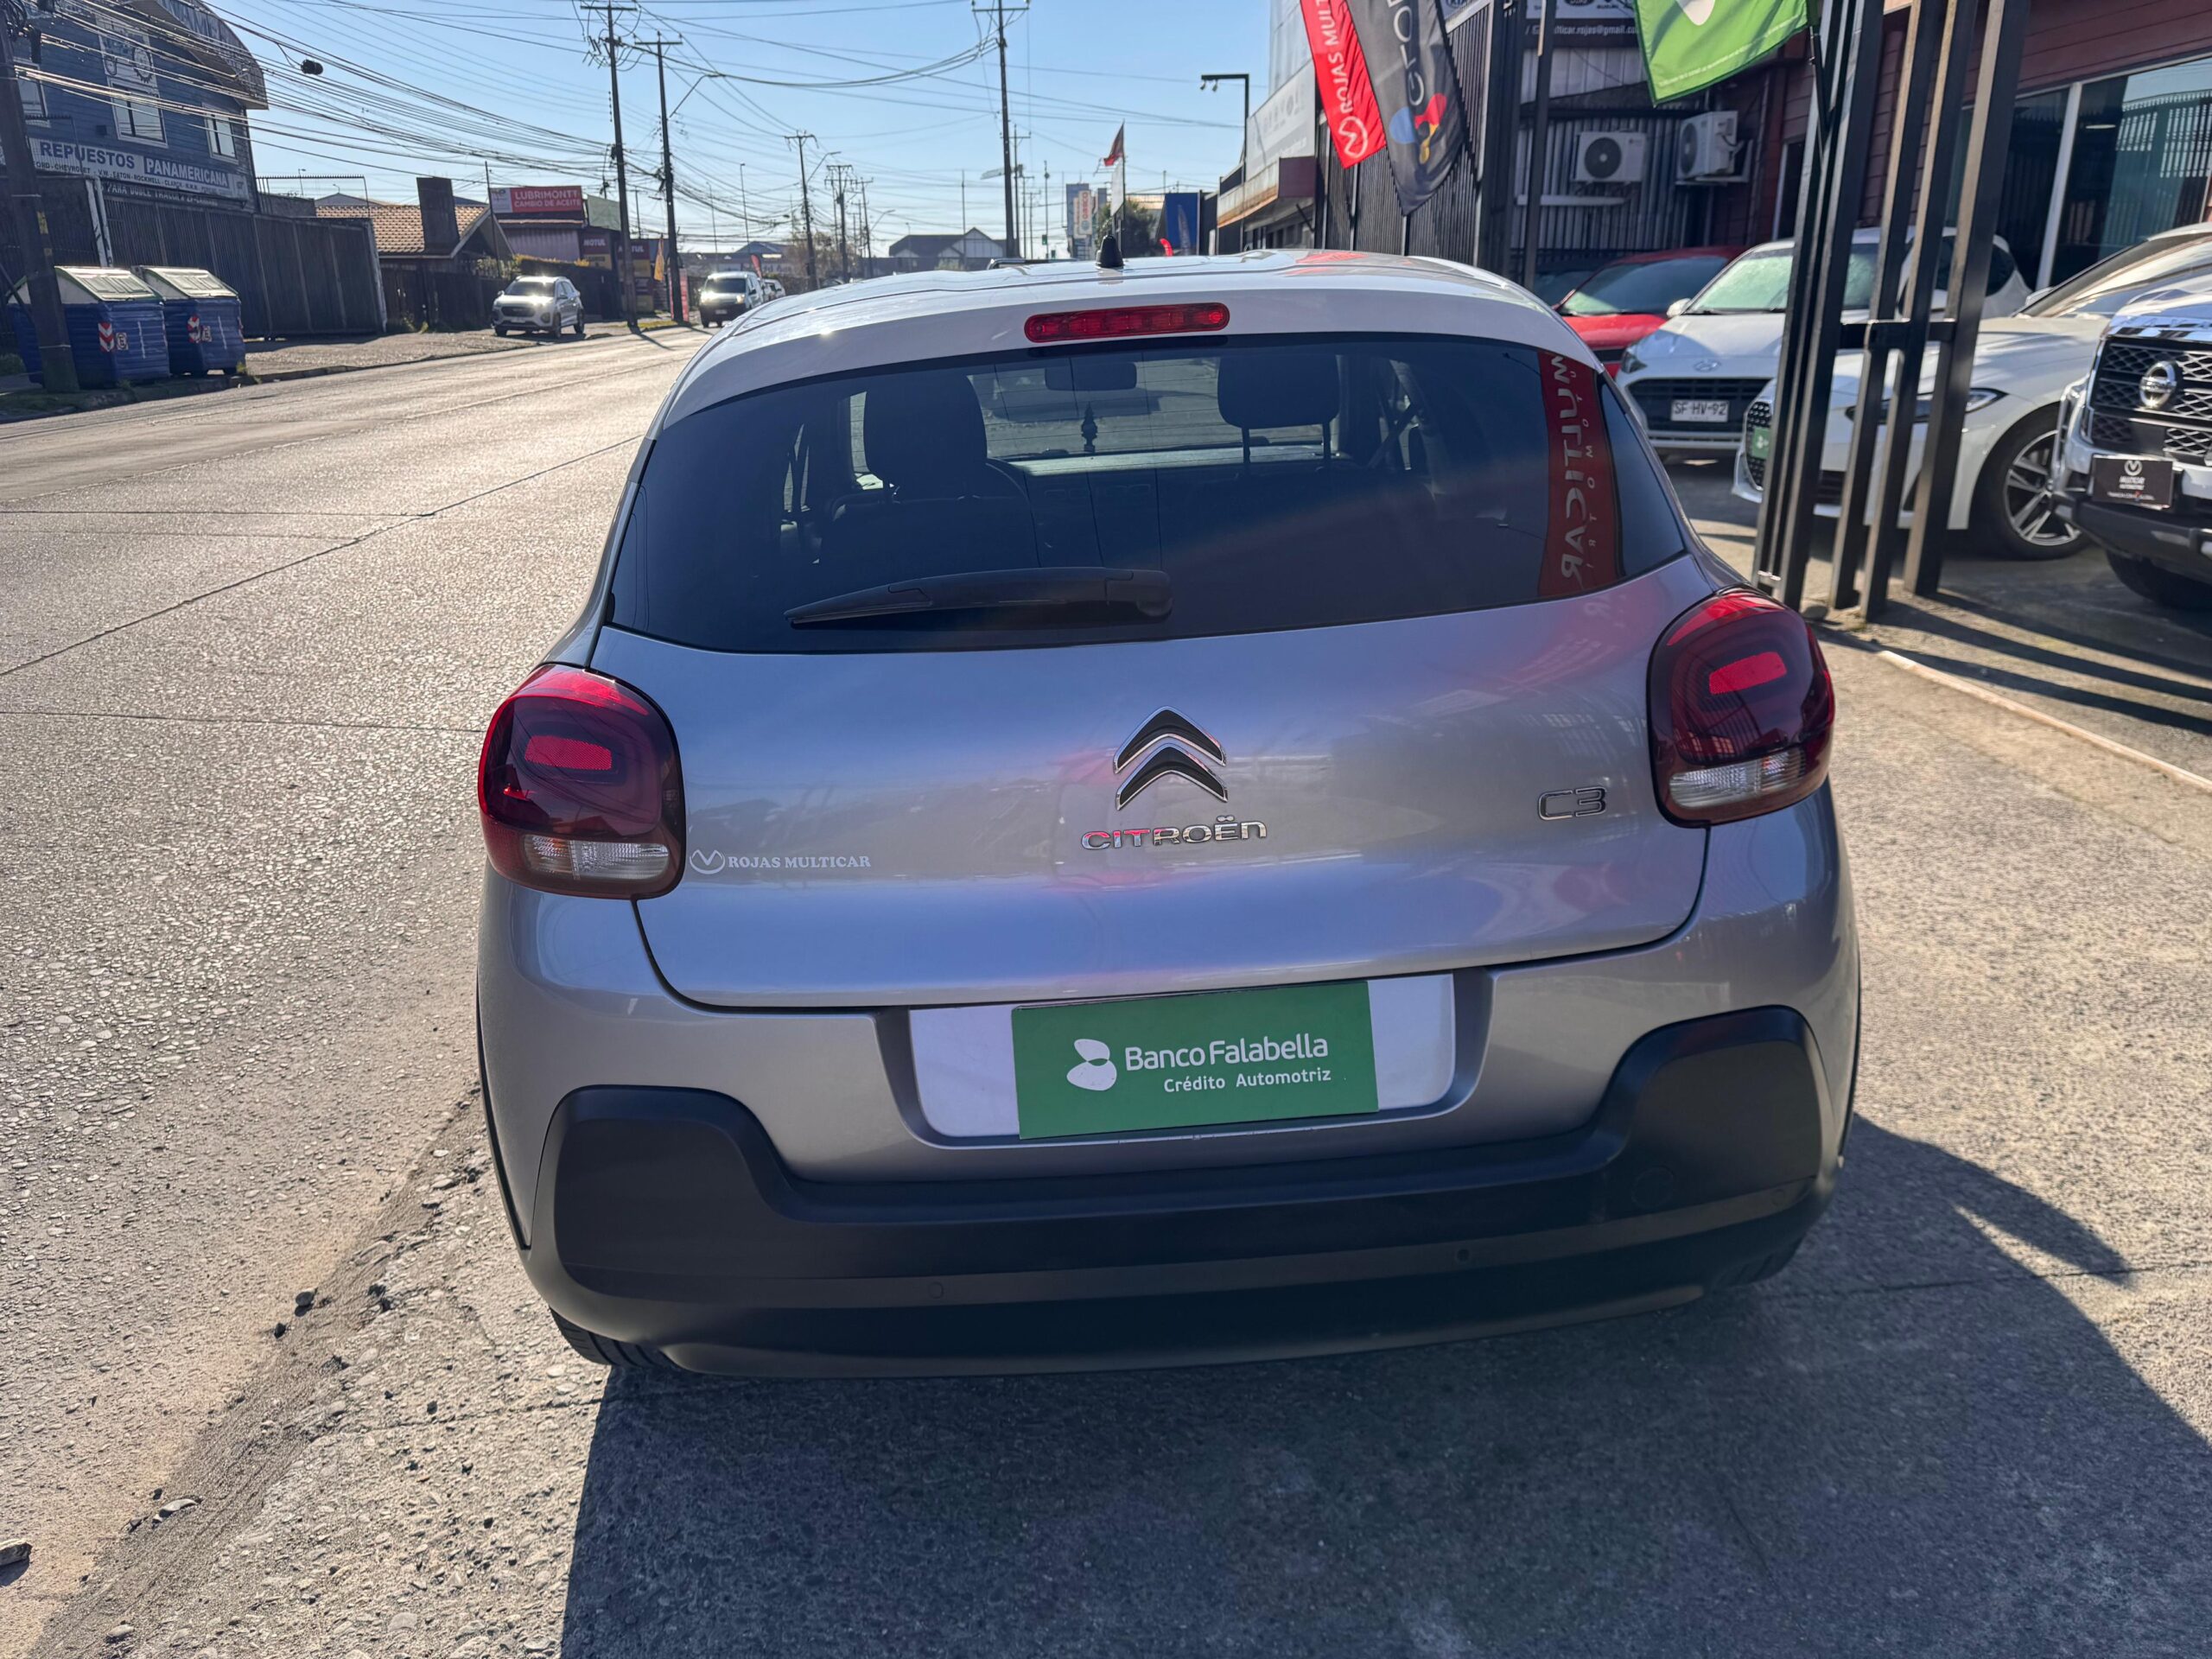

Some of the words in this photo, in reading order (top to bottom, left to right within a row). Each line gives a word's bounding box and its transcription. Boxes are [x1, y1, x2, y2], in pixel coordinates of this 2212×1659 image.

[1327, 52, 1354, 114] ROJAS
[39, 141, 135, 169] REPUESTOS
[145, 157, 228, 187] PANAMERICANA
[1675, 401, 1688, 415] SF
[1538, 785, 1607, 821] C3
[728, 856, 781, 868] ROJAS
[785, 855, 872, 868] MULTICAR
[1125, 1046, 1206, 1071] Banco
[1209, 1033, 1328, 1065] Falabella
[1164, 1075, 1225, 1093] Crédito
[1236, 1067, 1332, 1088] Automotriz
